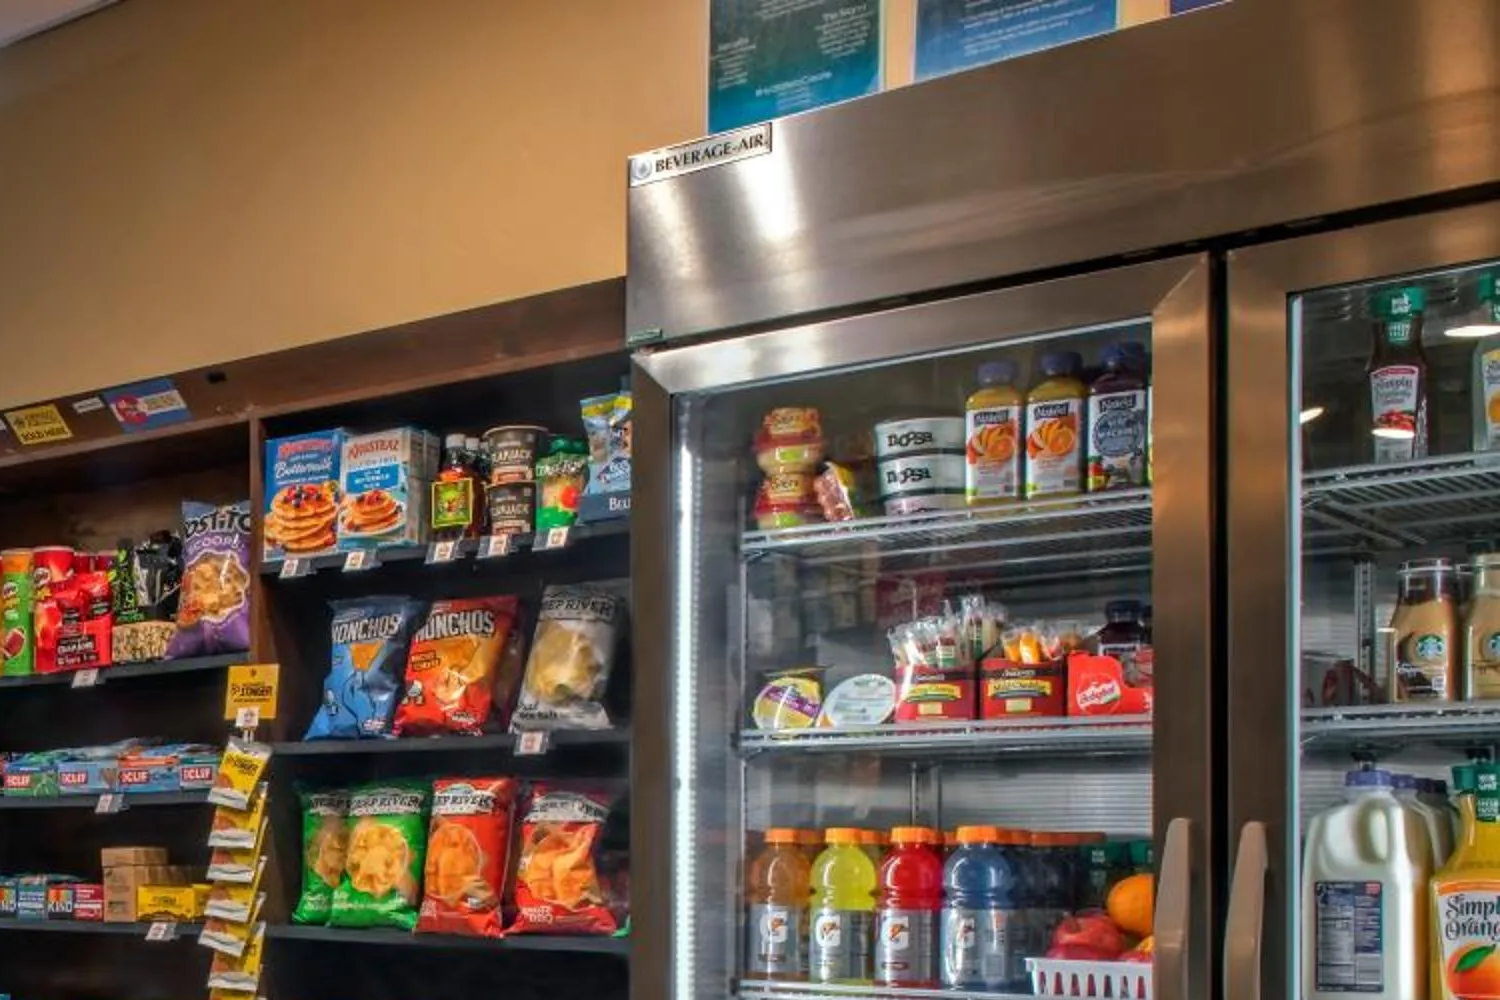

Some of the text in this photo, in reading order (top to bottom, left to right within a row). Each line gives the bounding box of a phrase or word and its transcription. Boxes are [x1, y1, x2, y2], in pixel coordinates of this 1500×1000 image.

[655, 134, 764, 173] BEVERAGE-AIR
[1445, 894, 1500, 918] Simpl
[1445, 919, 1500, 942] Orang
